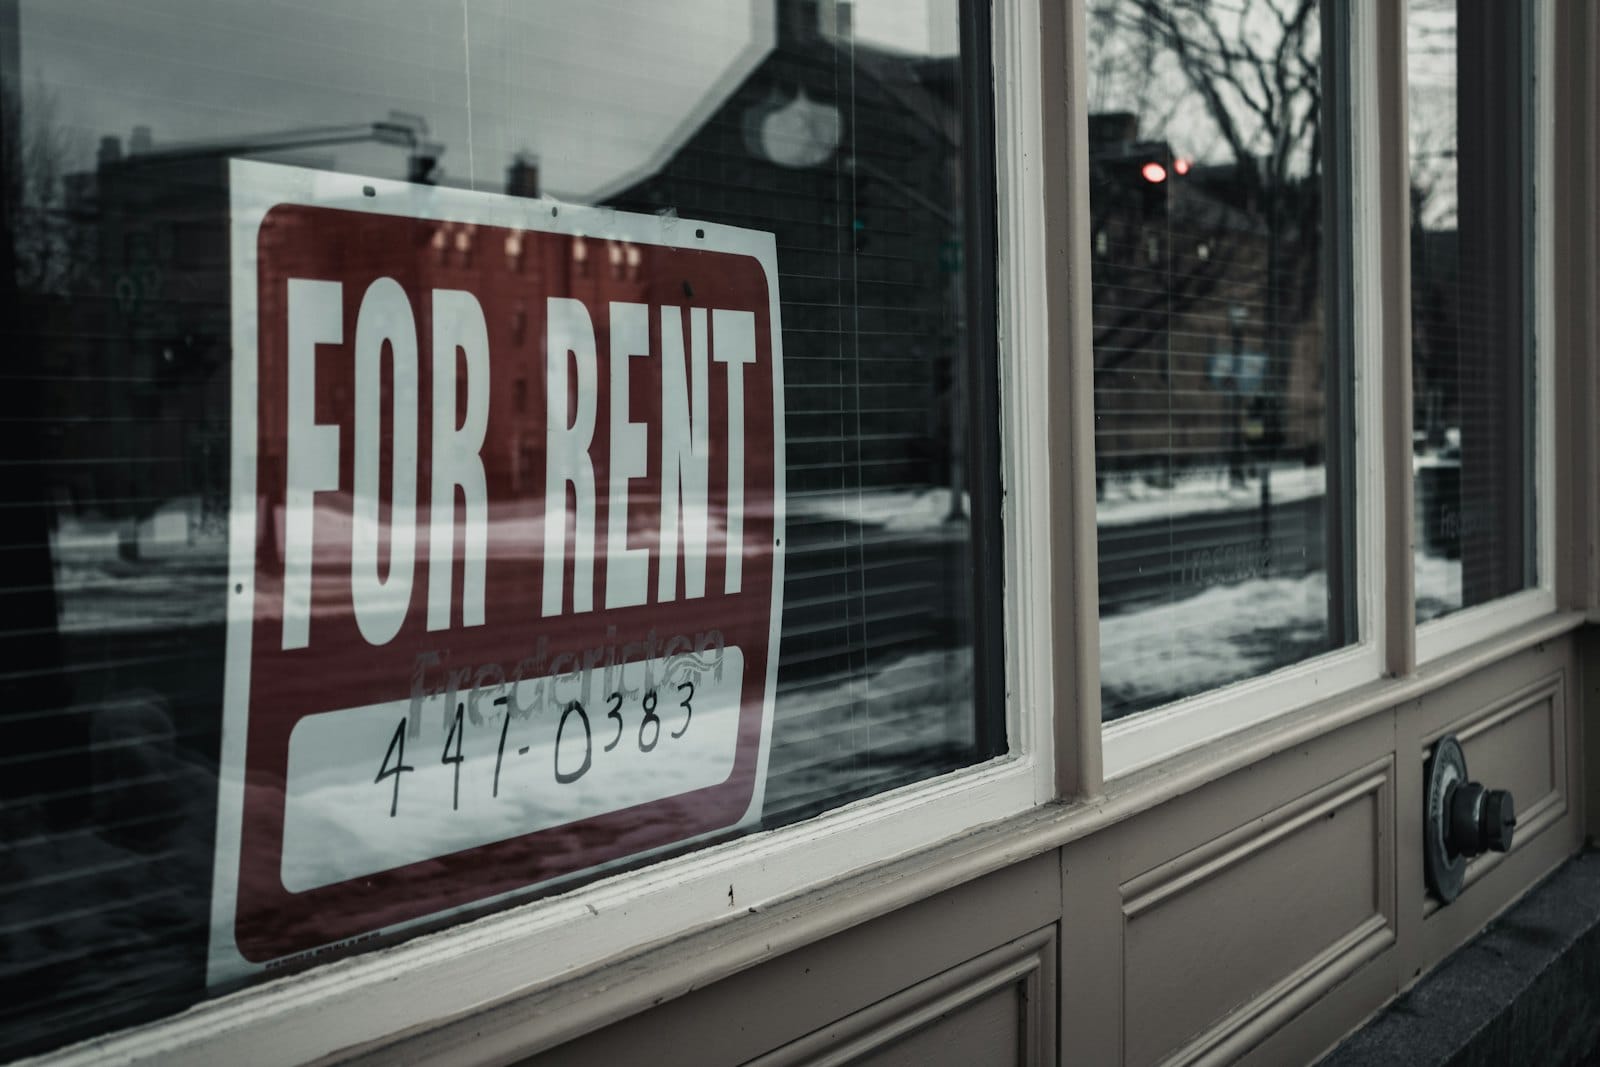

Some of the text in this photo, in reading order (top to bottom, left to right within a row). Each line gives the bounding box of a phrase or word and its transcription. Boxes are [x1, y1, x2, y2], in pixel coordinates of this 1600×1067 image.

[281, 276, 757, 651] FOR RENT
[374, 681, 695, 817] 447-0383
[407, 625, 725, 740] Fredericton
